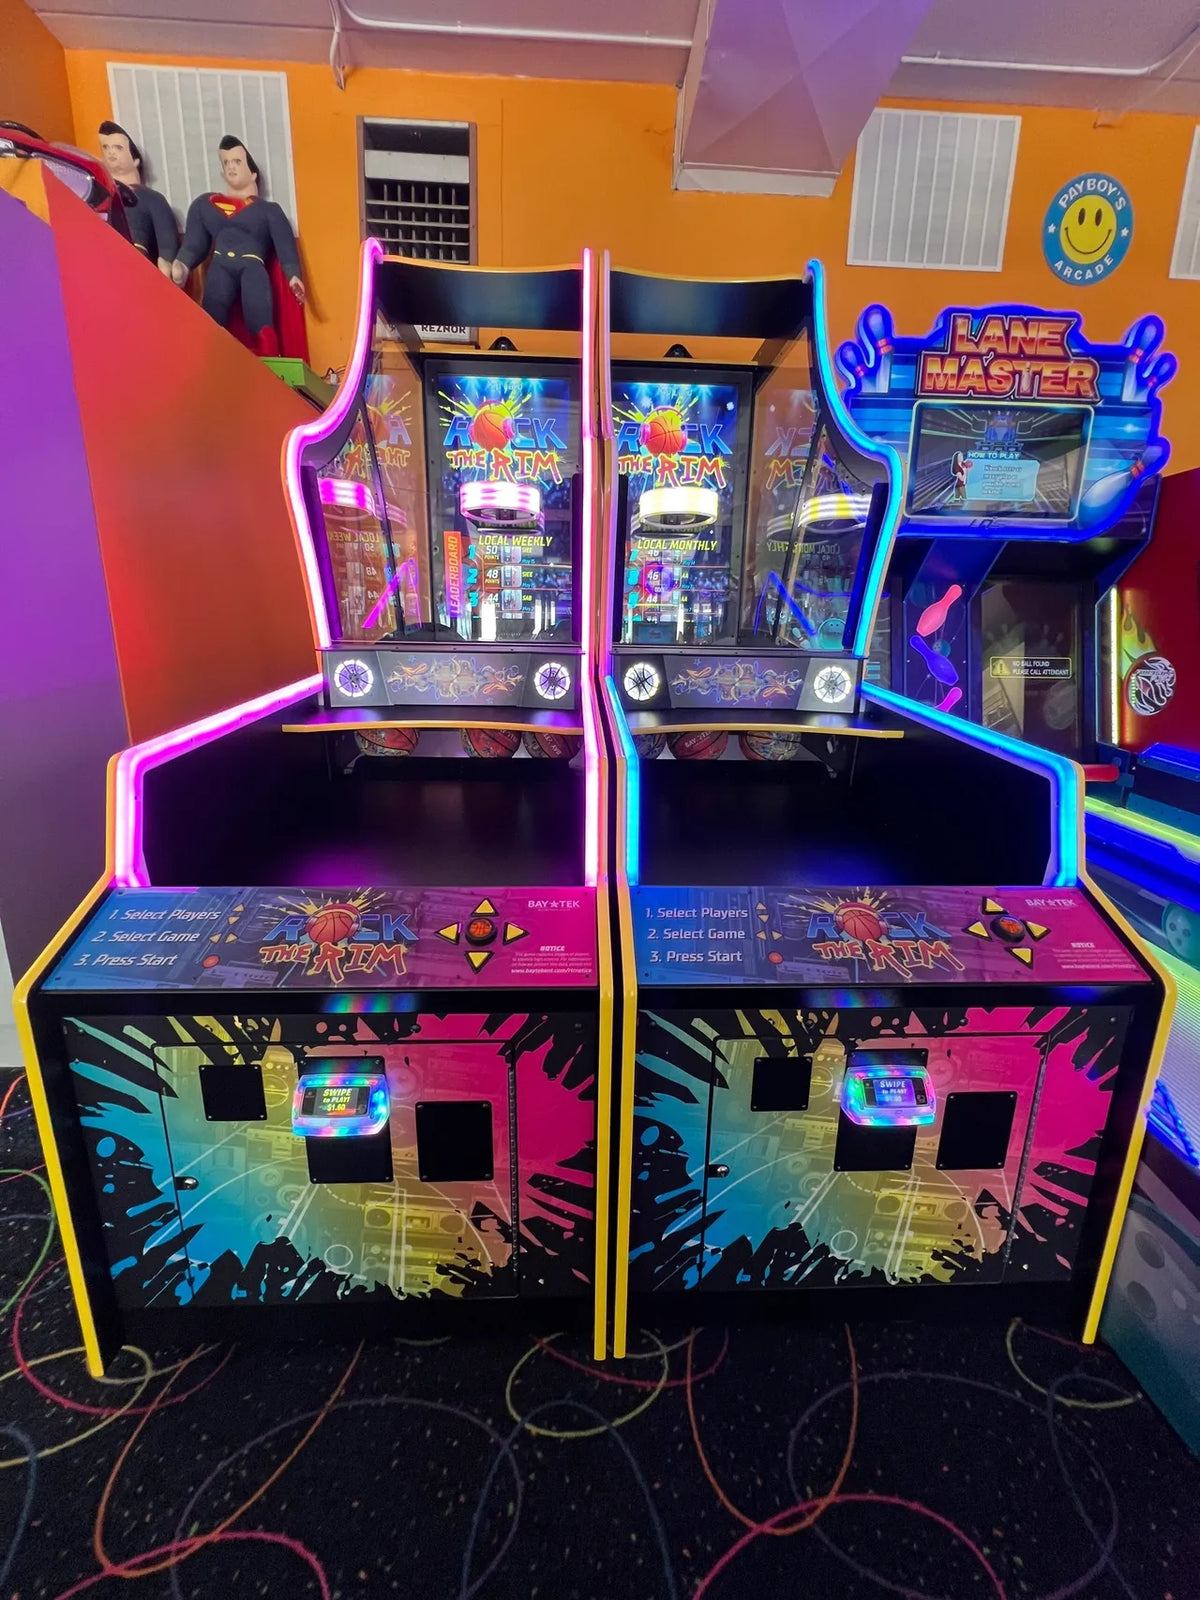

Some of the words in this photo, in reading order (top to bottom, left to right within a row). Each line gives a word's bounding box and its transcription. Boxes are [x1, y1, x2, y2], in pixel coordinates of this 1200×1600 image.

[1058, 178, 1127, 211] PAYBOY'S
[1054, 254, 1114, 281] ARCADE
[421, 325, 466, 333] REZNOR
[953, 315, 1072, 357] LANE
[923, 355, 1097, 397] MASTER
[446, 449, 487, 469] THE
[491, 447, 563, 484] RIM
[618, 454, 653, 475] THE
[657, 453, 727, 489] RIM
[479, 535, 509, 545] LOCAL
[512, 536, 552, 547] WEEKLY
[637, 540, 667, 550] LOCAL
[669, 540, 718, 550] MONTHLY
[486, 545, 498, 554] 50
[448, 535, 460, 614] LEADERBOARD
[486, 569, 499, 578] 48
[528, 900, 549, 908] BAY
[559, 900, 580, 908] TEK
[108, 910, 117, 920] 1.
[120, 909, 165, 920] Select
[167, 909, 221, 922] Players
[645, 908, 653, 918] 1.
[657, 908, 697, 918] Select
[701, 908, 749, 920] Players
[109, 931, 156, 942] Select
[157, 931, 200, 942] Game
[647, 929, 659, 939] 2.
[663, 929, 704, 939] Select
[708, 929, 746, 939] Game
[74, 954, 88, 966] 3.
[92, 954, 135, 966] Press
[136, 954, 178, 966] Start
[650, 951, 662, 962] 3.
[666, 951, 704, 962] Press
[707, 951, 742, 962] Start
[812, 941, 866, 960] THE
[865, 939, 966, 978] RIM
[259, 943, 312, 963] THE
[313, 942, 407, 984] RIM
[323, 1088, 352, 1097] SWIPE
